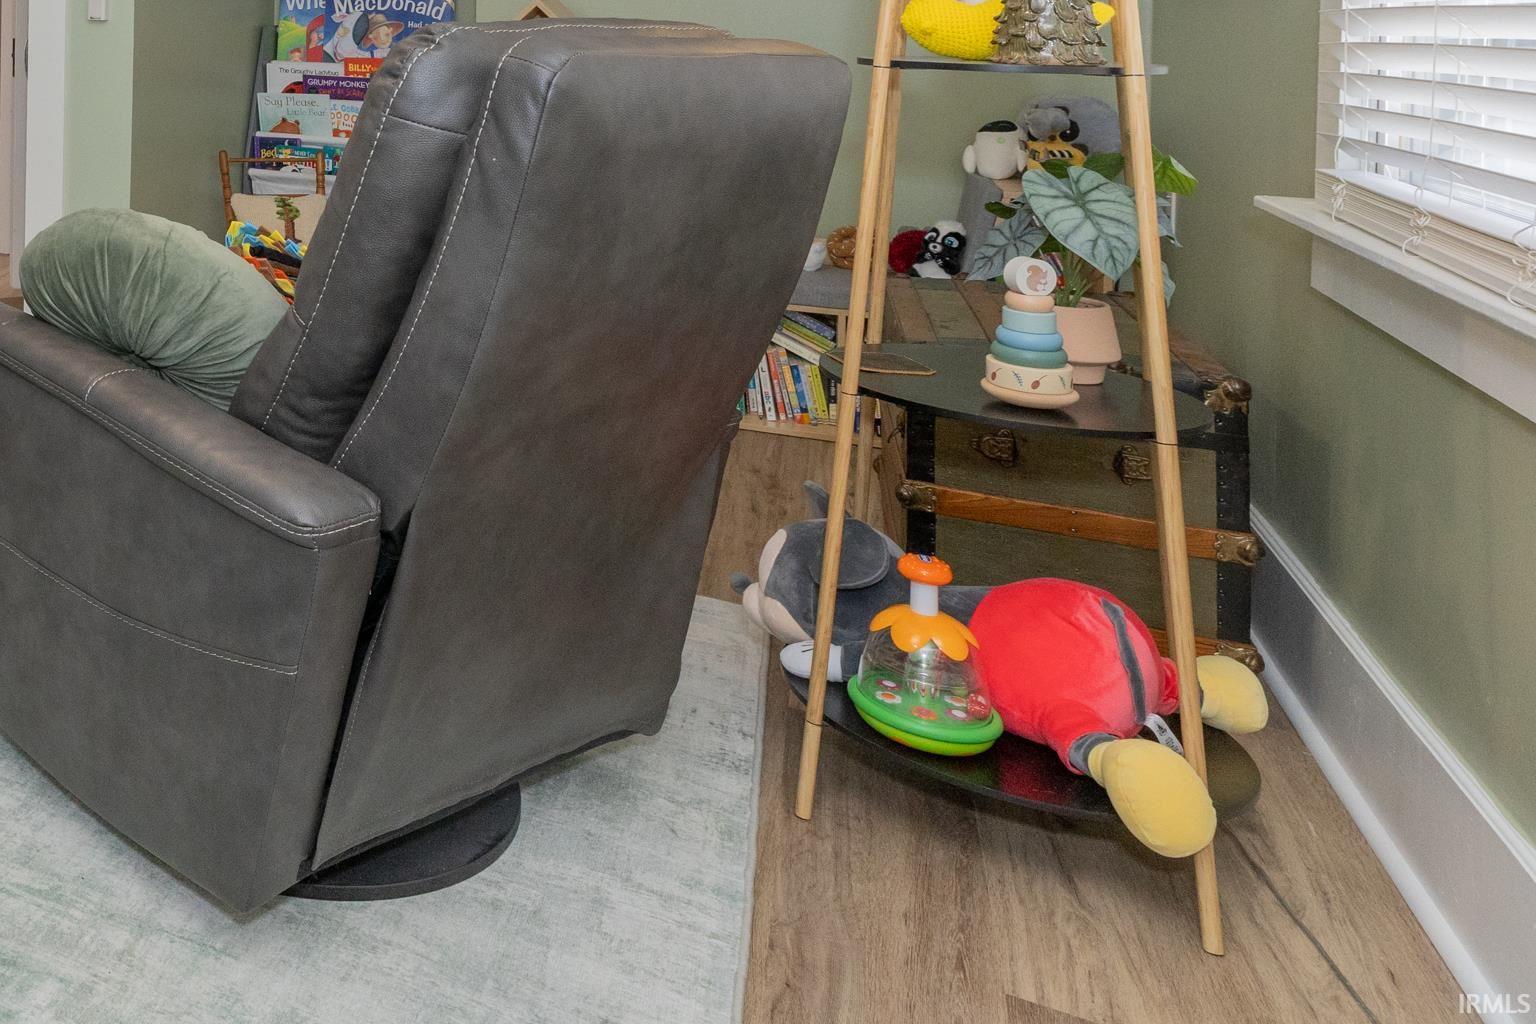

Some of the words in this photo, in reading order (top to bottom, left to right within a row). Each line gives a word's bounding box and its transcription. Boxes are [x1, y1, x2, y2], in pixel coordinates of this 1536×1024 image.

[348, 63, 371, 72] BILLY
[307, 78, 336, 86] GRUMPY
[339, 80, 369, 88] MONKEY
[264, 96, 283, 107] Say
[260, 147, 277, 158] Bed
